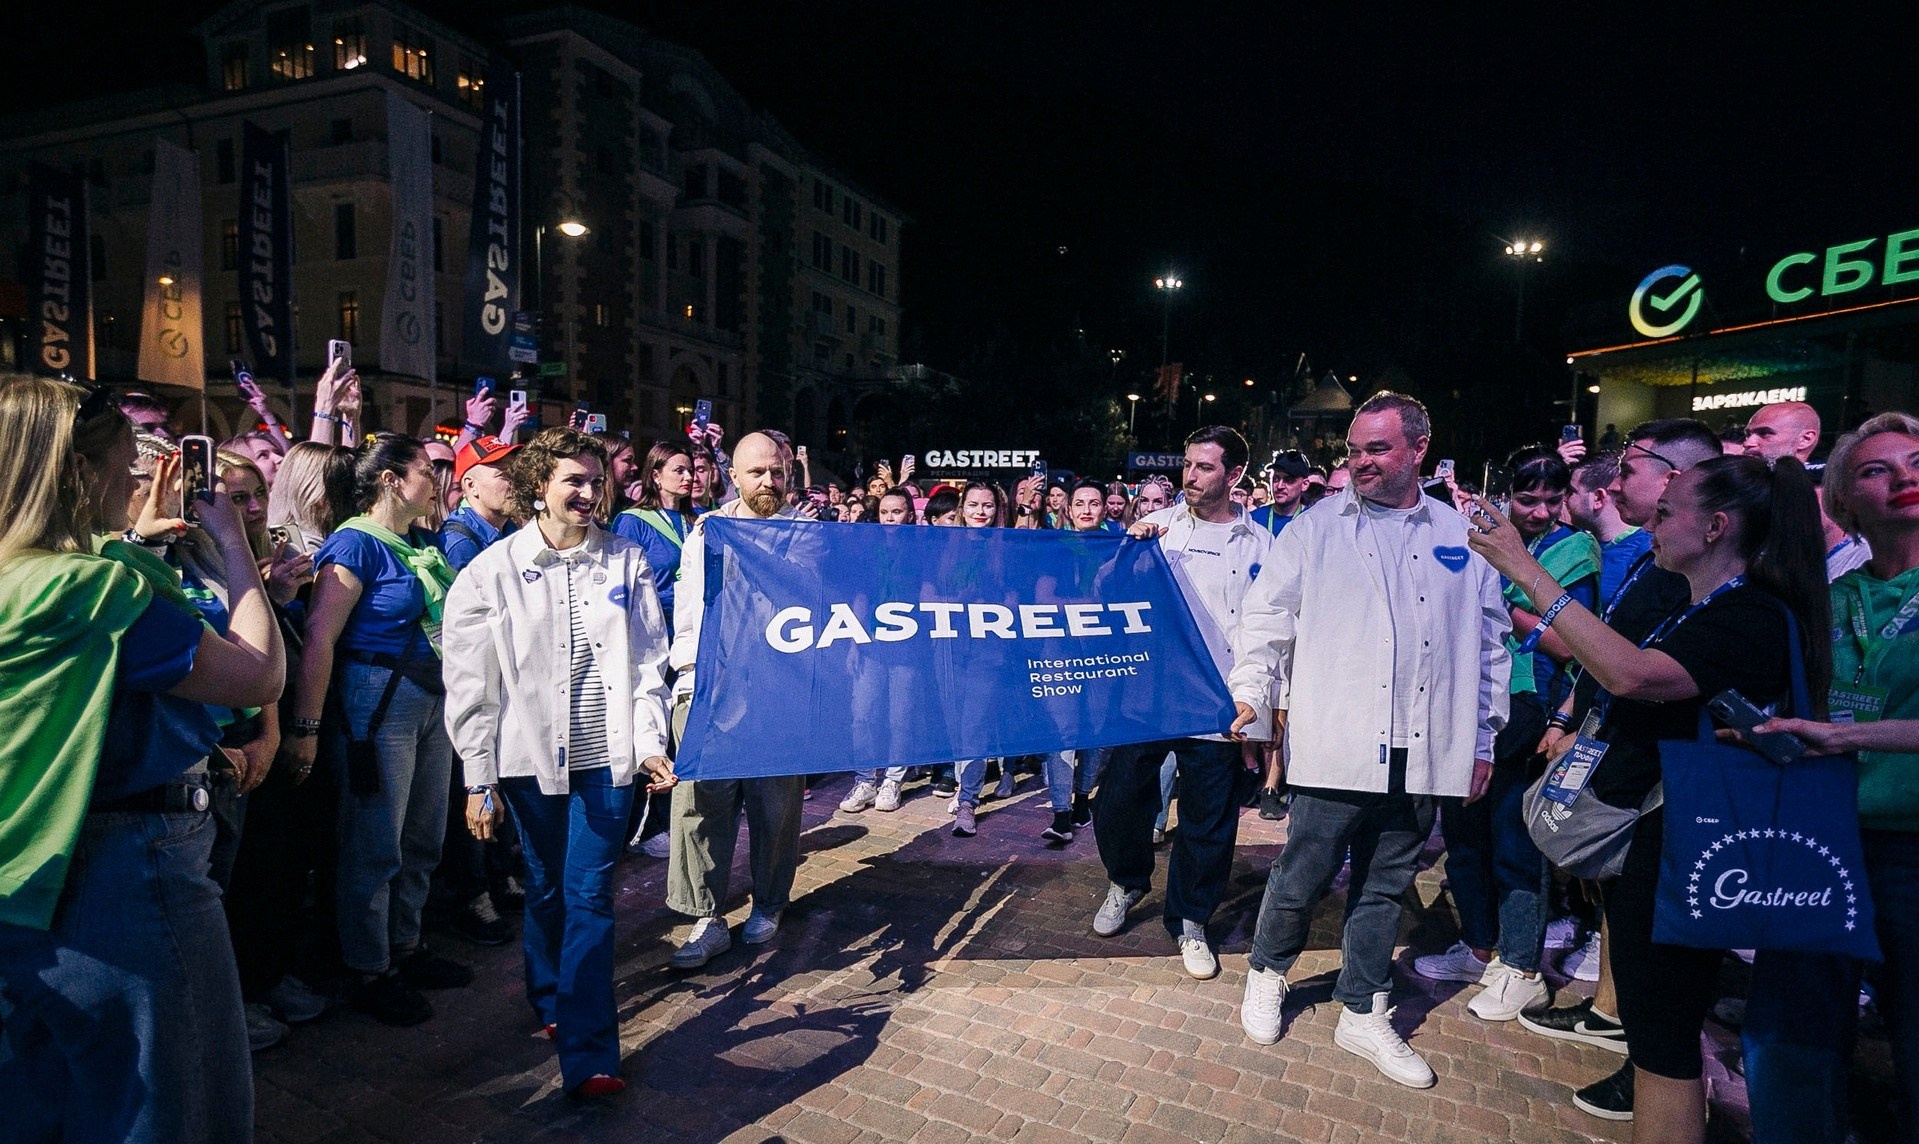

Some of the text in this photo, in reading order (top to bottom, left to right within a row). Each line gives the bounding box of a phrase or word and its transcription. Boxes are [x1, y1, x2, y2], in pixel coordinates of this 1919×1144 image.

[1766, 230, 1919, 303] СБЕ
[1692, 387, 1806, 412] ЗАРЯЖАЕМ!
[925, 449, 1040, 468] GASTREET
[1135, 455, 1186, 467] GASTR
[1542, 594, 1573, 625] ПРОФИ
[765, 601, 1153, 654] GASTREET
[1027, 651, 1150, 671] International
[1029, 665, 1138, 684] Restaurant
[1032, 681, 1083, 699] Show
[1827, 696, 1880, 713] ОЛОНТЕР
[1574, 743, 1603, 758] GASTREET
[1541, 809, 1559, 833] adidas
[1709, 868, 1832, 910] Gastreet
